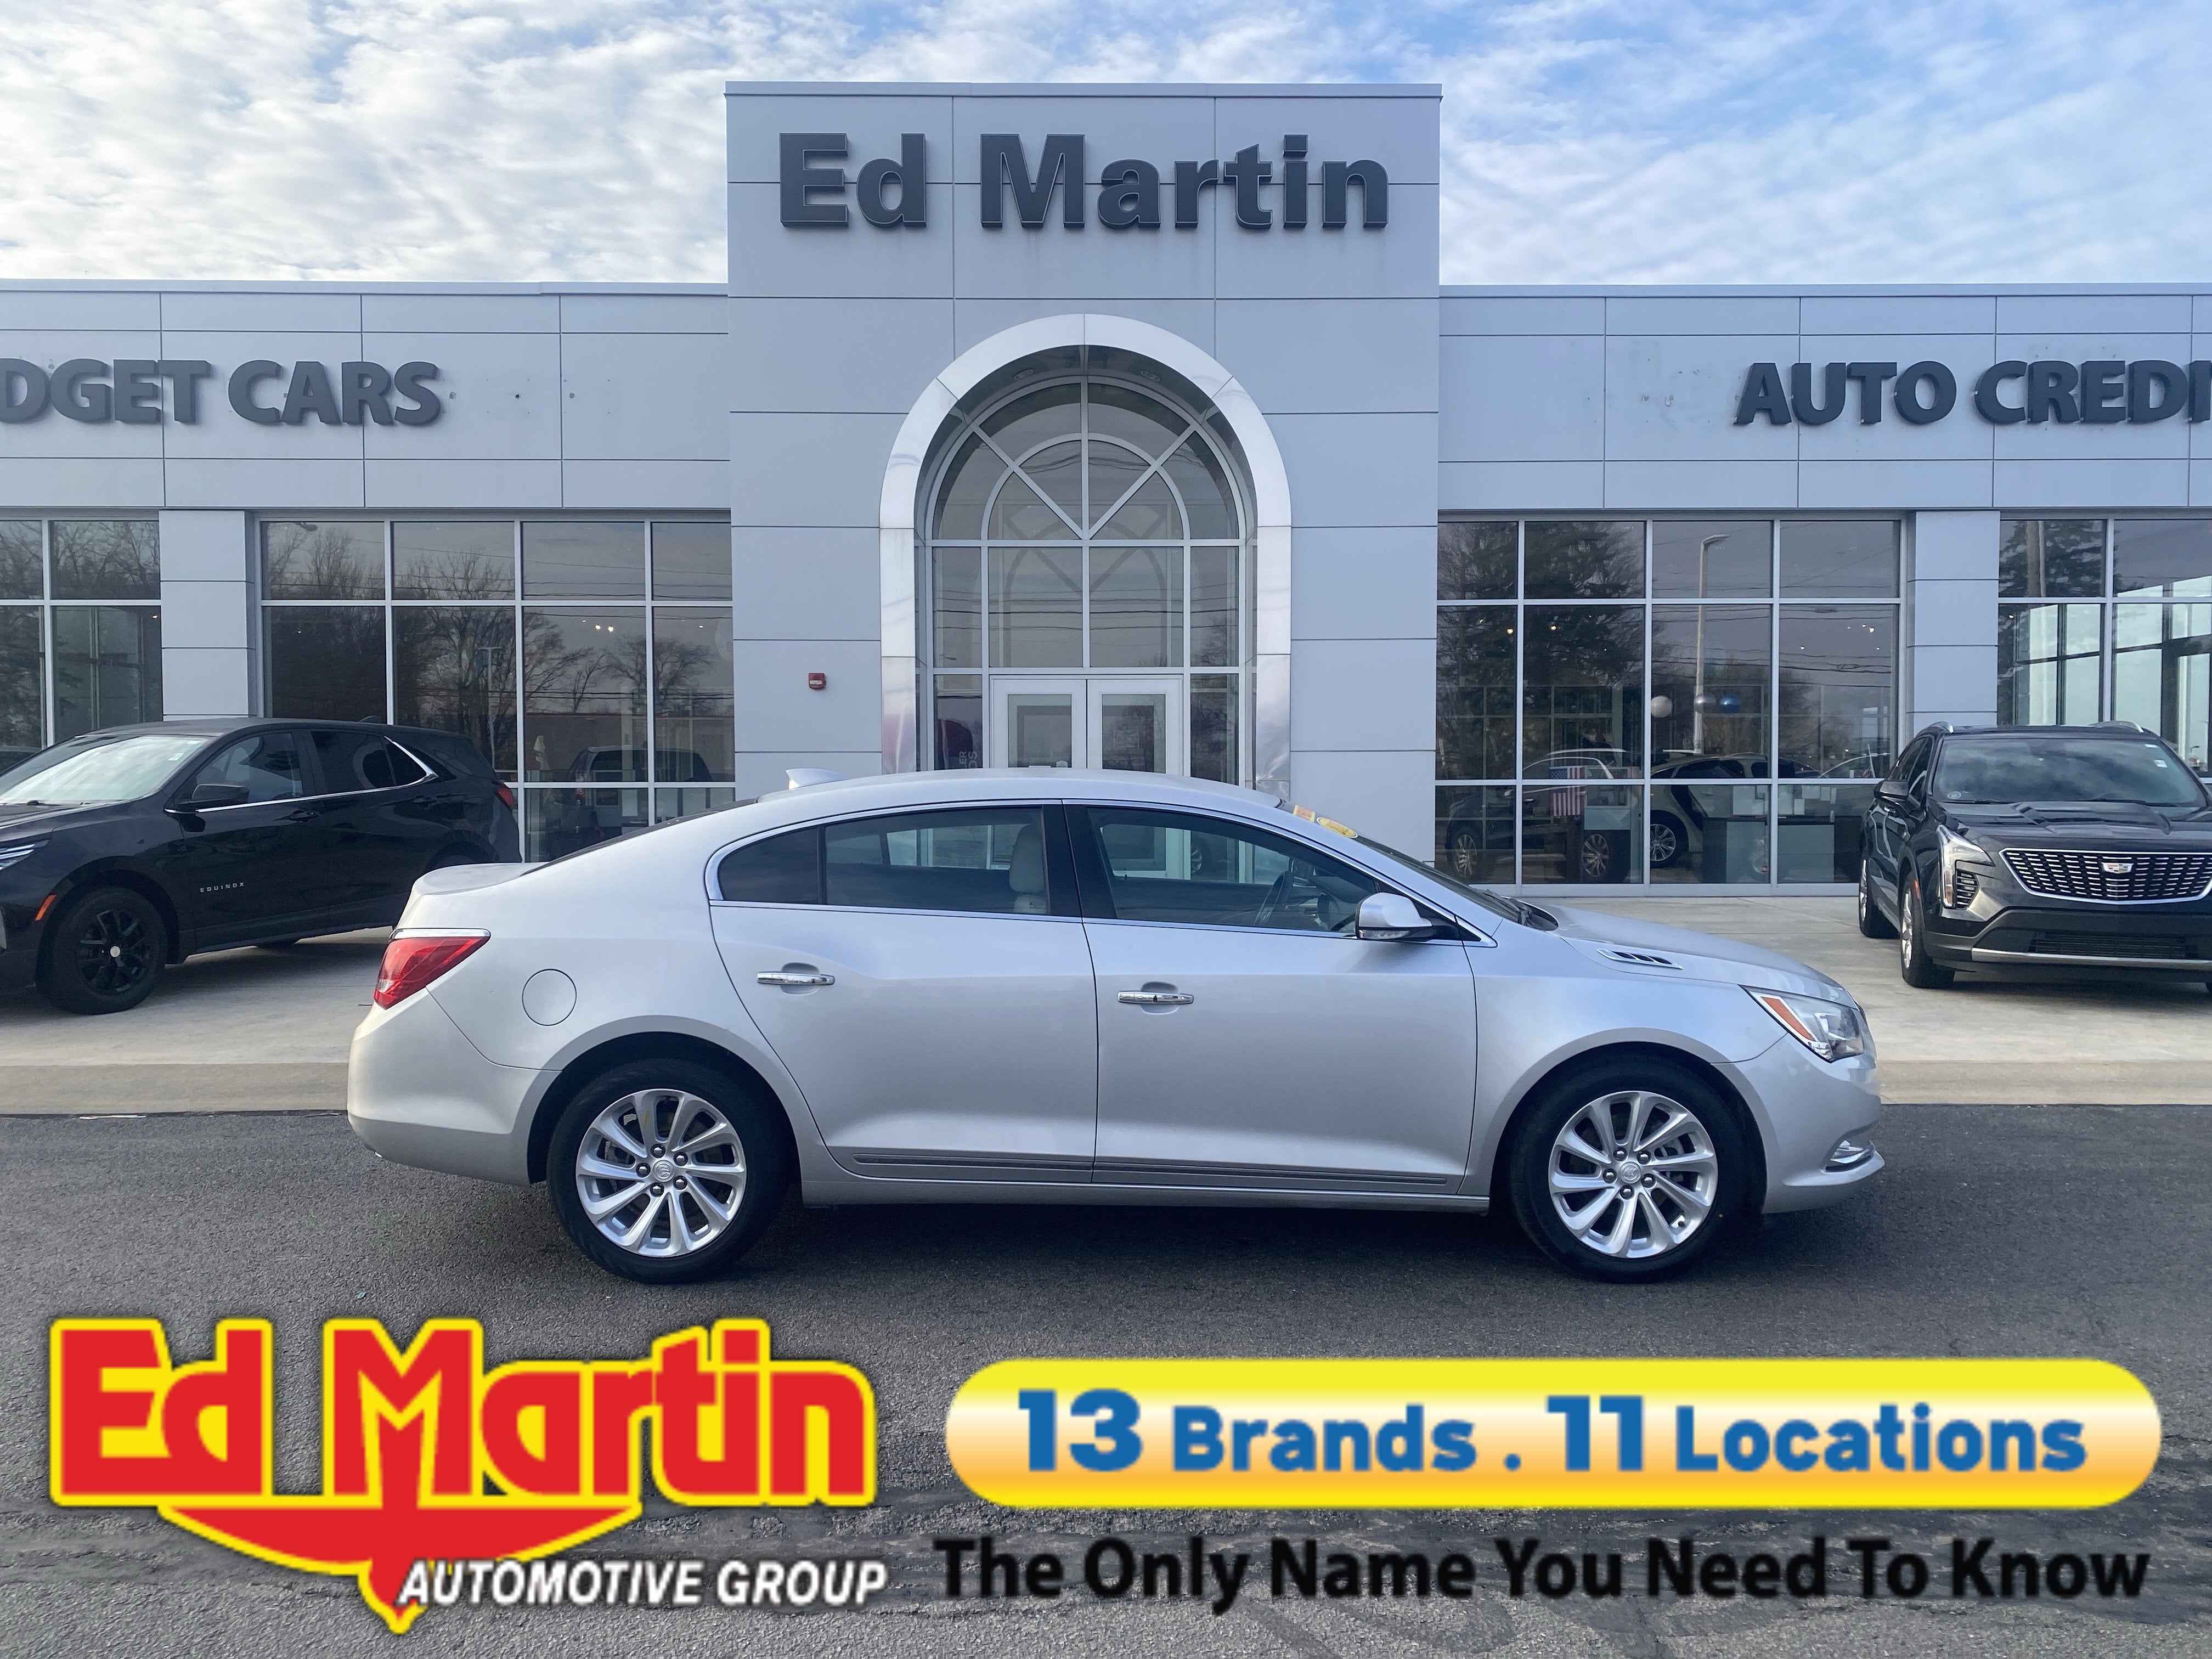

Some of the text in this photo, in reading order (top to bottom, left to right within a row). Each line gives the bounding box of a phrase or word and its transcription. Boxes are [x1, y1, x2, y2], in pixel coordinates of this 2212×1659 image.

[779, 133, 1389, 229] Ed Martin
[0, 358, 441, 426] DGET CARS
[1734, 360, 2212, 424] AUTO CREDI
